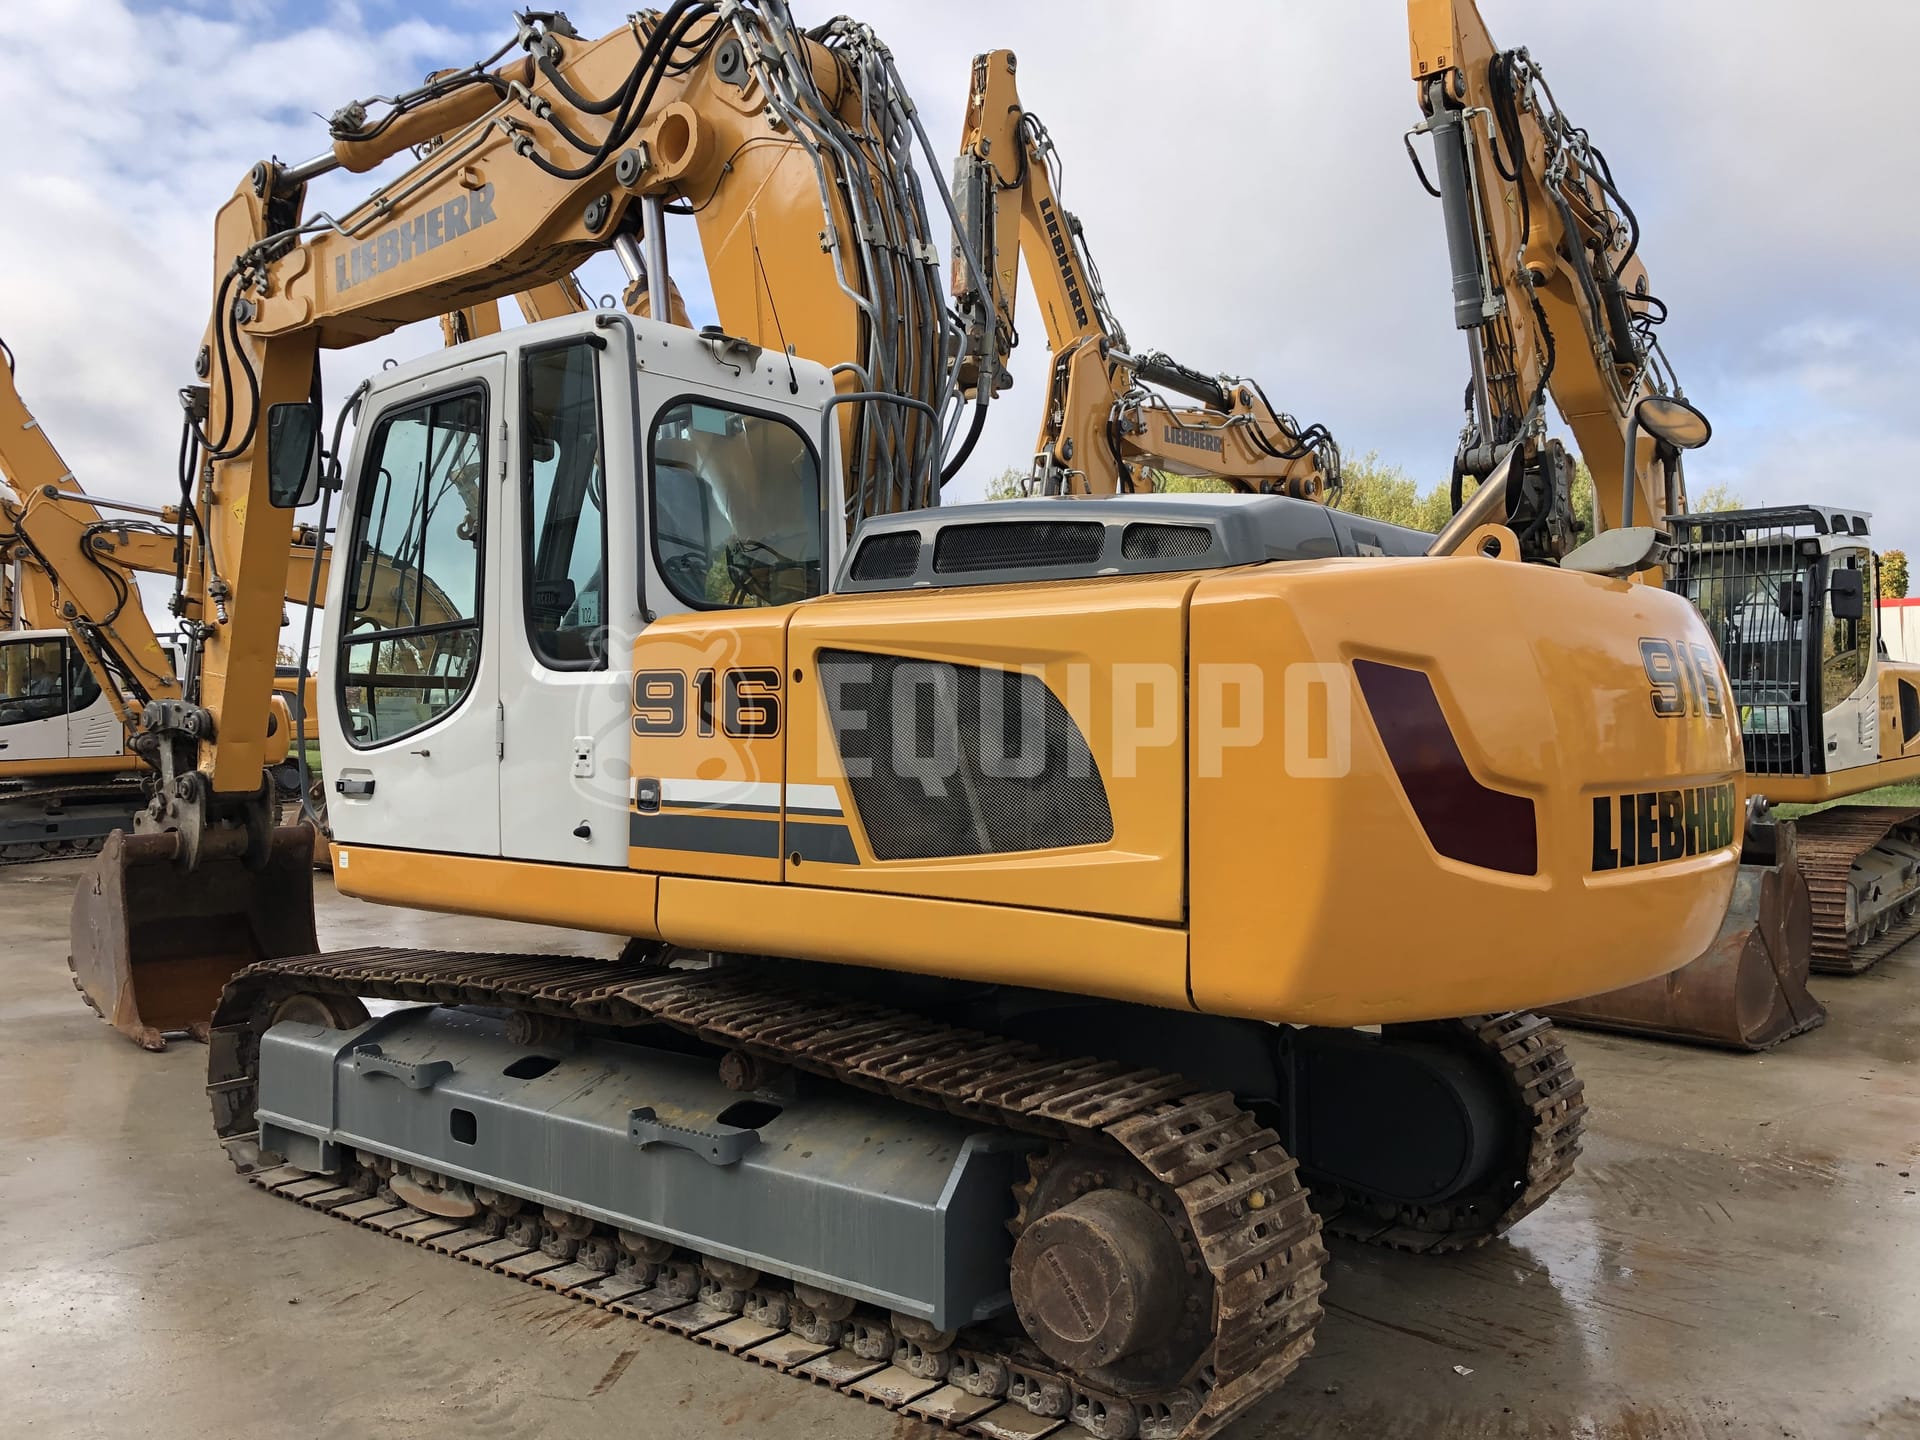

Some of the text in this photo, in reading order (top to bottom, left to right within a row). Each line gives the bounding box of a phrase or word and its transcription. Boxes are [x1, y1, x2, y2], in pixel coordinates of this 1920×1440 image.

[336, 182, 498, 294] LIEBHERR
[1039, 197, 1089, 331] LIEBHERR
[1164, 425, 1223, 453] LIEBHERR
[632, 666, 781, 739] 916
[1638, 637, 1724, 719] 916
